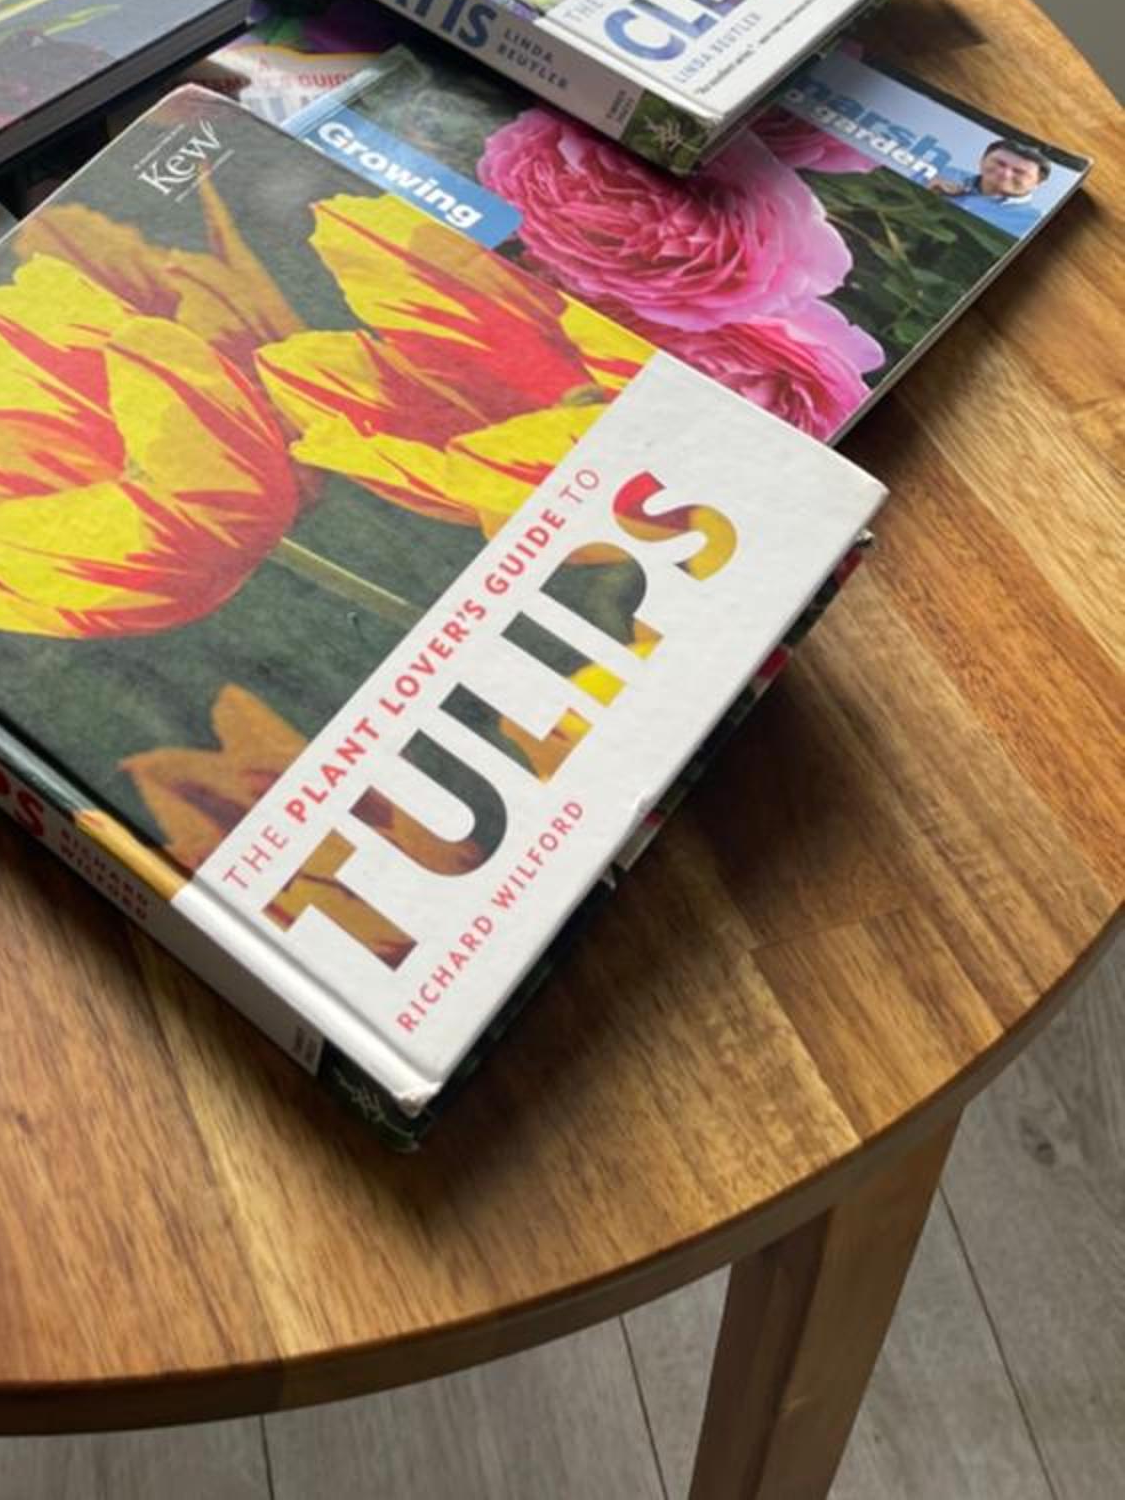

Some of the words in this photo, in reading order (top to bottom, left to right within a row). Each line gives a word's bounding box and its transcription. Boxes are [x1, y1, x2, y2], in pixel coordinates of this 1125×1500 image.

[504, 28, 553, 62] LINDA
[137, 118, 224, 195] Kew
[315, 120, 485, 229] Growing
[812, 106, 938, 181] garden
[223, 824, 290, 891] THE
[284, 715, 382, 825] PLANT
[378, 597, 487, 717] LOVER'S
[484, 509, 567, 596] GUIDE
[558, 466, 600, 508] TO
[260, 469, 738, 974] TULIPS
[395, 912, 496, 1034] RICHARD
[490, 797, 586, 912] WILFORD
